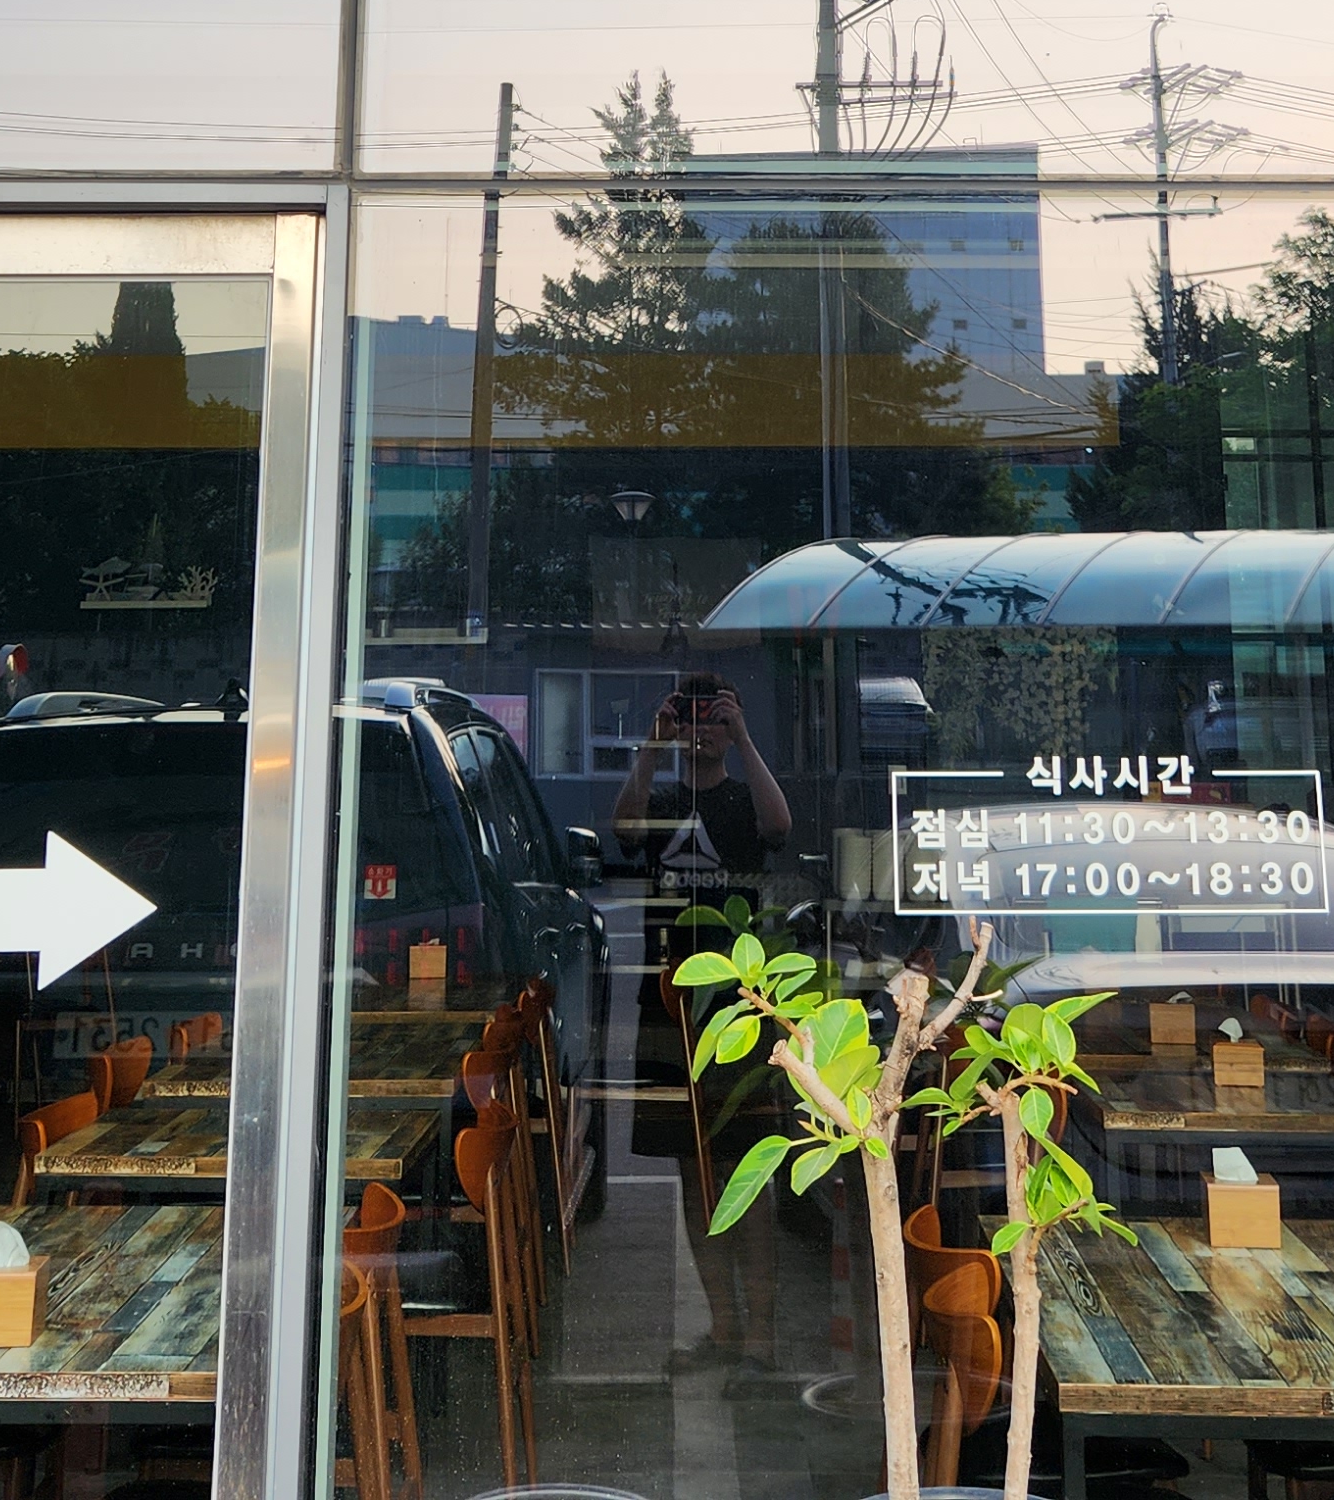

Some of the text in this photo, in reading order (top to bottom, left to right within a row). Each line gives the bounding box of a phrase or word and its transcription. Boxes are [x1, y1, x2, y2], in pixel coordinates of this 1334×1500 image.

[1026, 755, 1195, 796] 식사시간
[911, 809, 1311, 850] 점심 11:30~13:30
[912, 860, 1315, 901] 저녁 17:00~18:30
